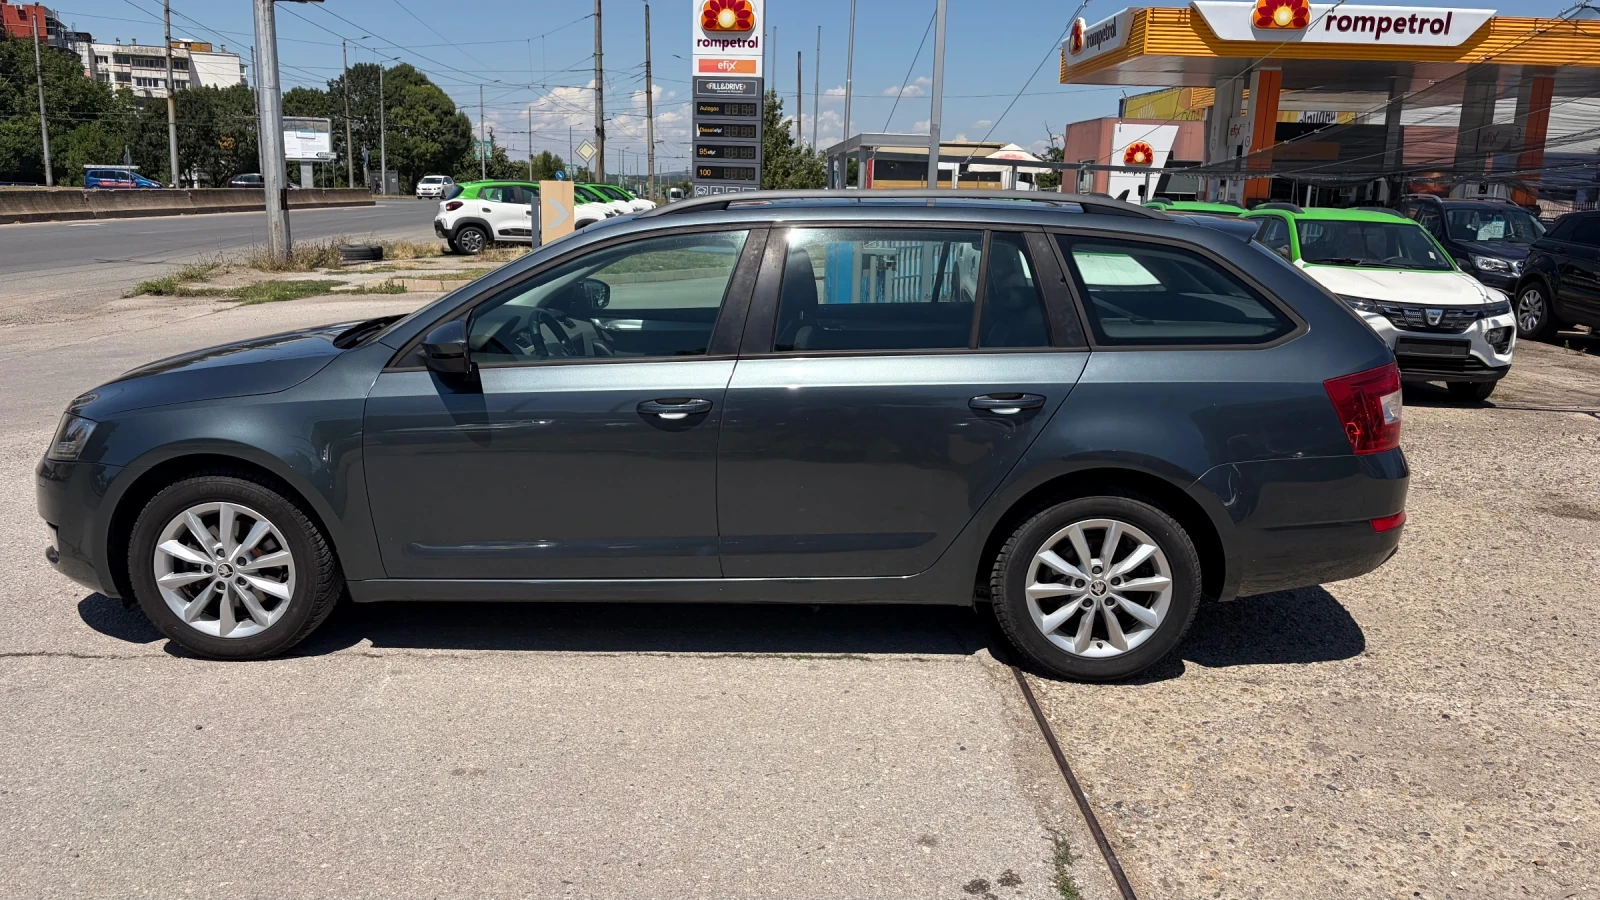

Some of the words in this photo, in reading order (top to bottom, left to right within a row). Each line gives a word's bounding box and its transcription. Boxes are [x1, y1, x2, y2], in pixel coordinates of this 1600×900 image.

[1086, 16, 1117, 50] rompetrol
[1325, 11, 1453, 41] rompetrol
[697, 36, 759, 51] rompetrol
[717, 60, 737, 71] efix
[700, 168, 711, 176] 100
